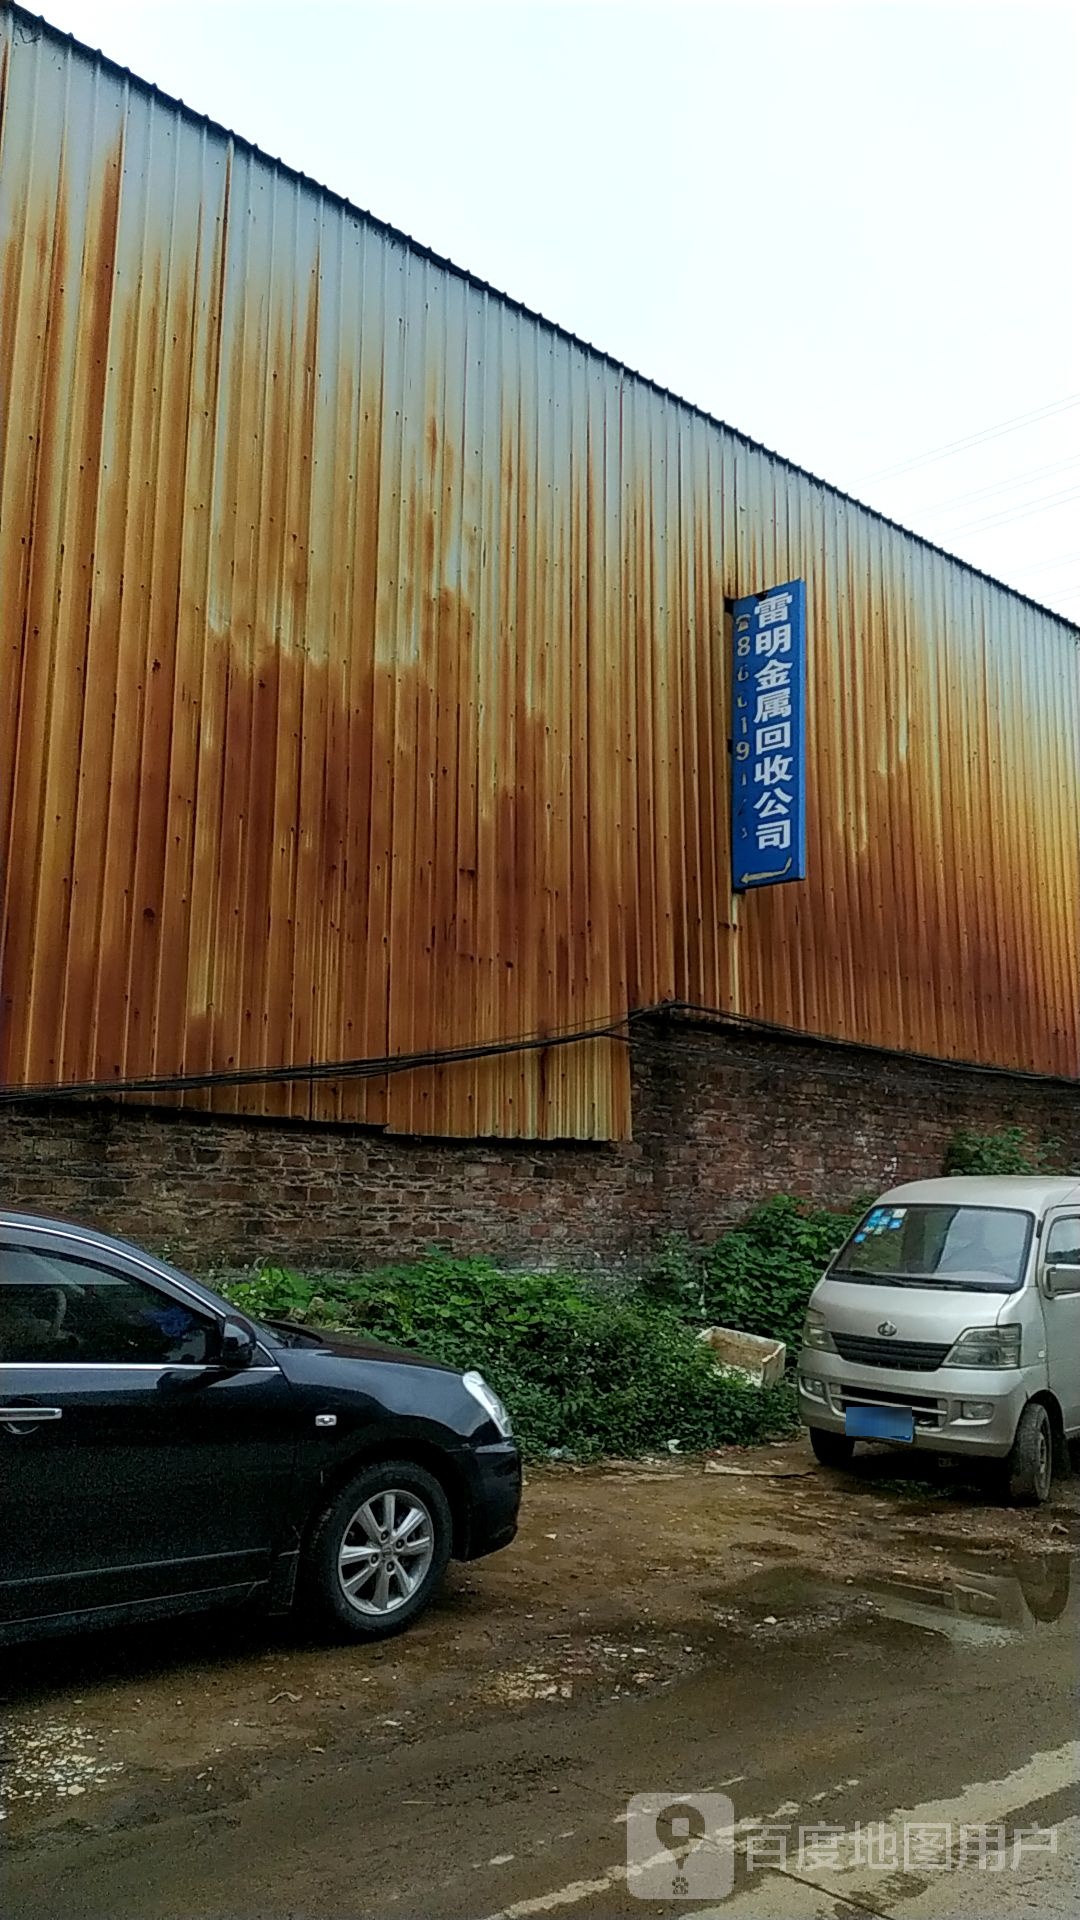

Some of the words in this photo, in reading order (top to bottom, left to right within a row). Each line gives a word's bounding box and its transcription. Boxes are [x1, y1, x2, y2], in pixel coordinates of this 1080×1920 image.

[754, 592, 793, 850] 雷明金属回收公司
